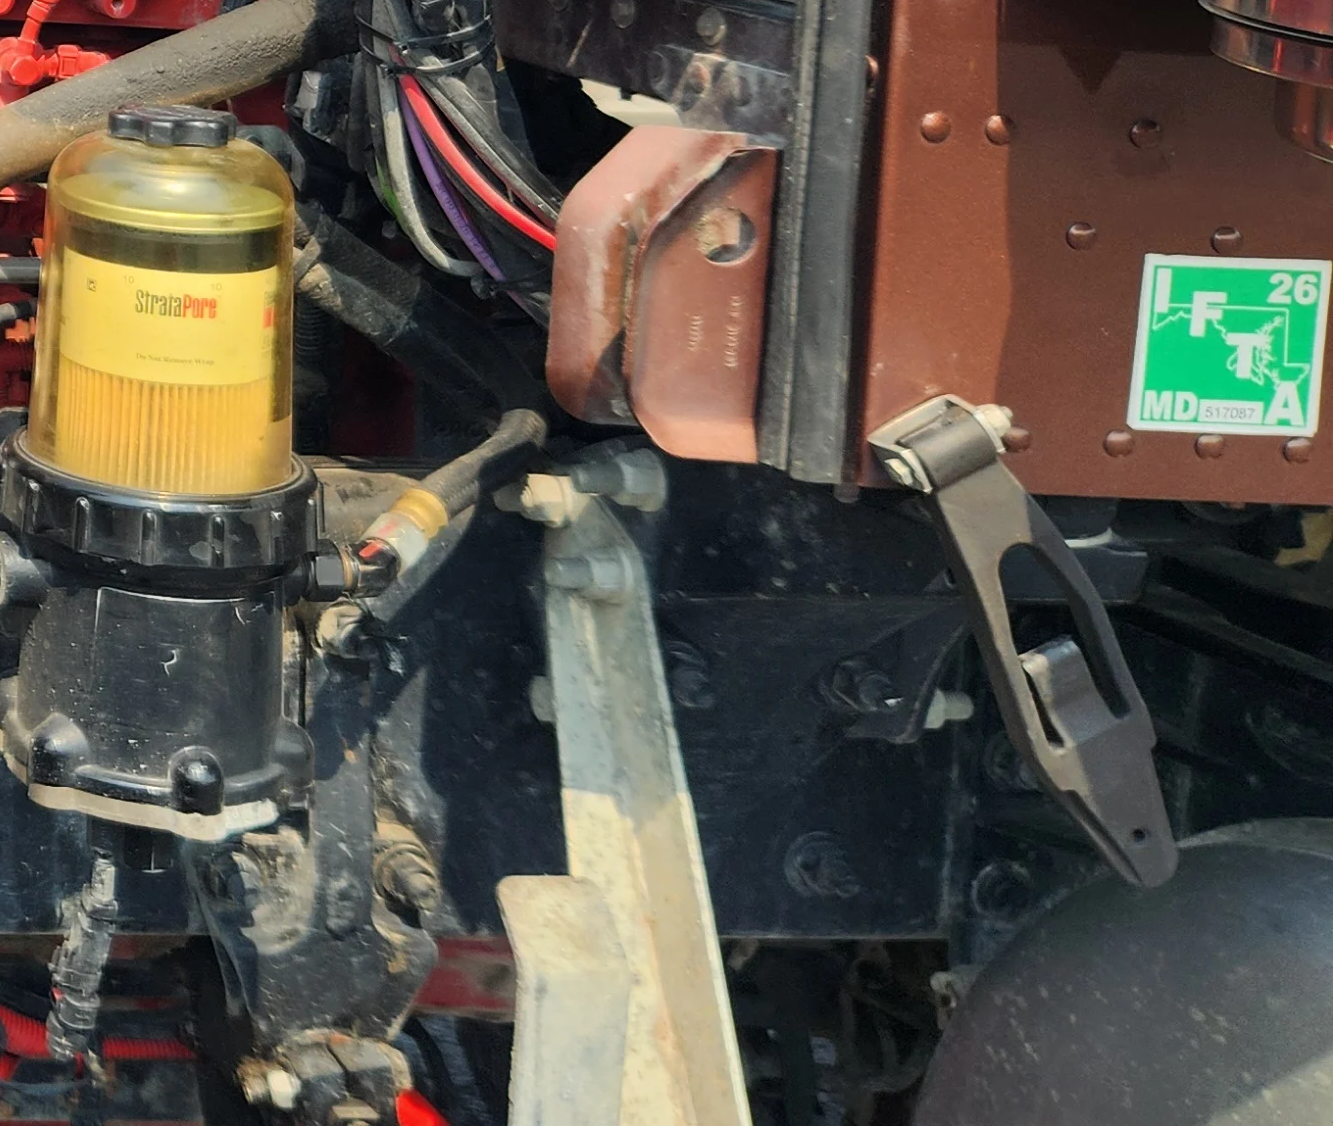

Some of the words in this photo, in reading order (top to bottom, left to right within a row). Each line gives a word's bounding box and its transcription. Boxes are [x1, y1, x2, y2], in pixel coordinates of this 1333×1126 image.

[135, 289, 218, 319] StrataPore
[1266, 272, 1318, 305] 26
[1142, 389, 1199, 421] MD
[1205, 406, 1257, 420] 517087
